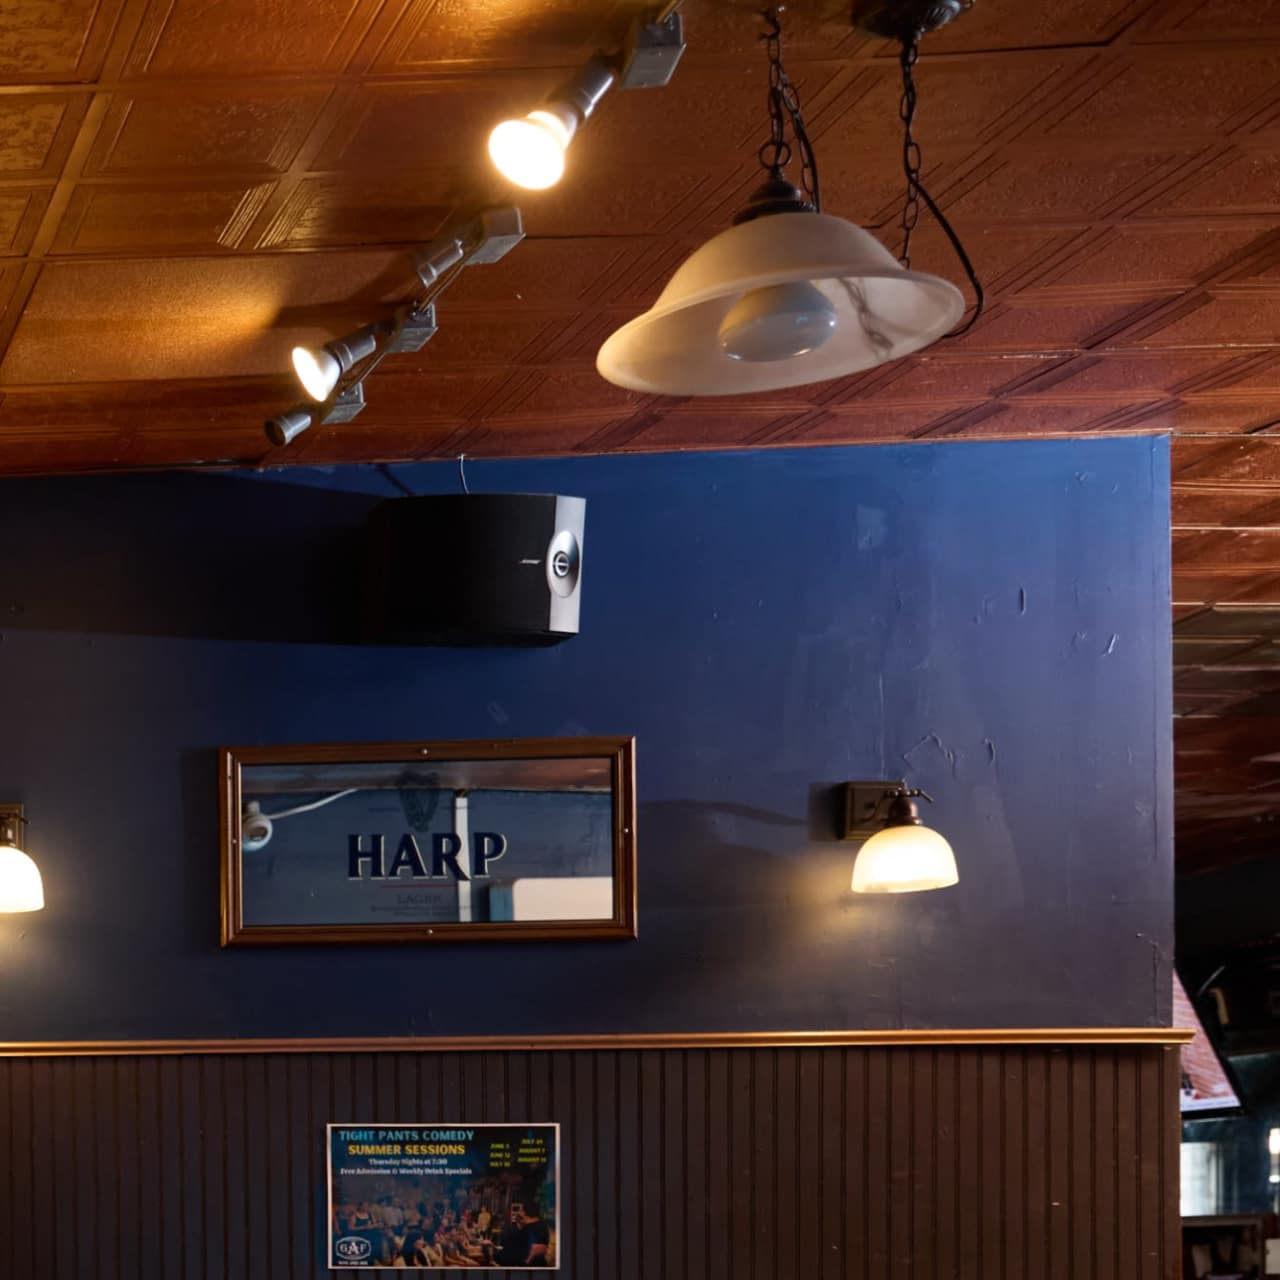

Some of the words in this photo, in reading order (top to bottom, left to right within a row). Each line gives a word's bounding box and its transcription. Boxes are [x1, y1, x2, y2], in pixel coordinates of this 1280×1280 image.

[348, 832, 508, 880] HARP
[339, 1130, 375, 1141] TIGHT
[378, 1131, 419, 1141] PANTS
[422, 1130, 474, 1141] COMEDY
[348, 1144, 401, 1155] SUMMER
[405, 1144, 465, 1155] SESSIONS
[340, 1242, 367, 1254] GAF
